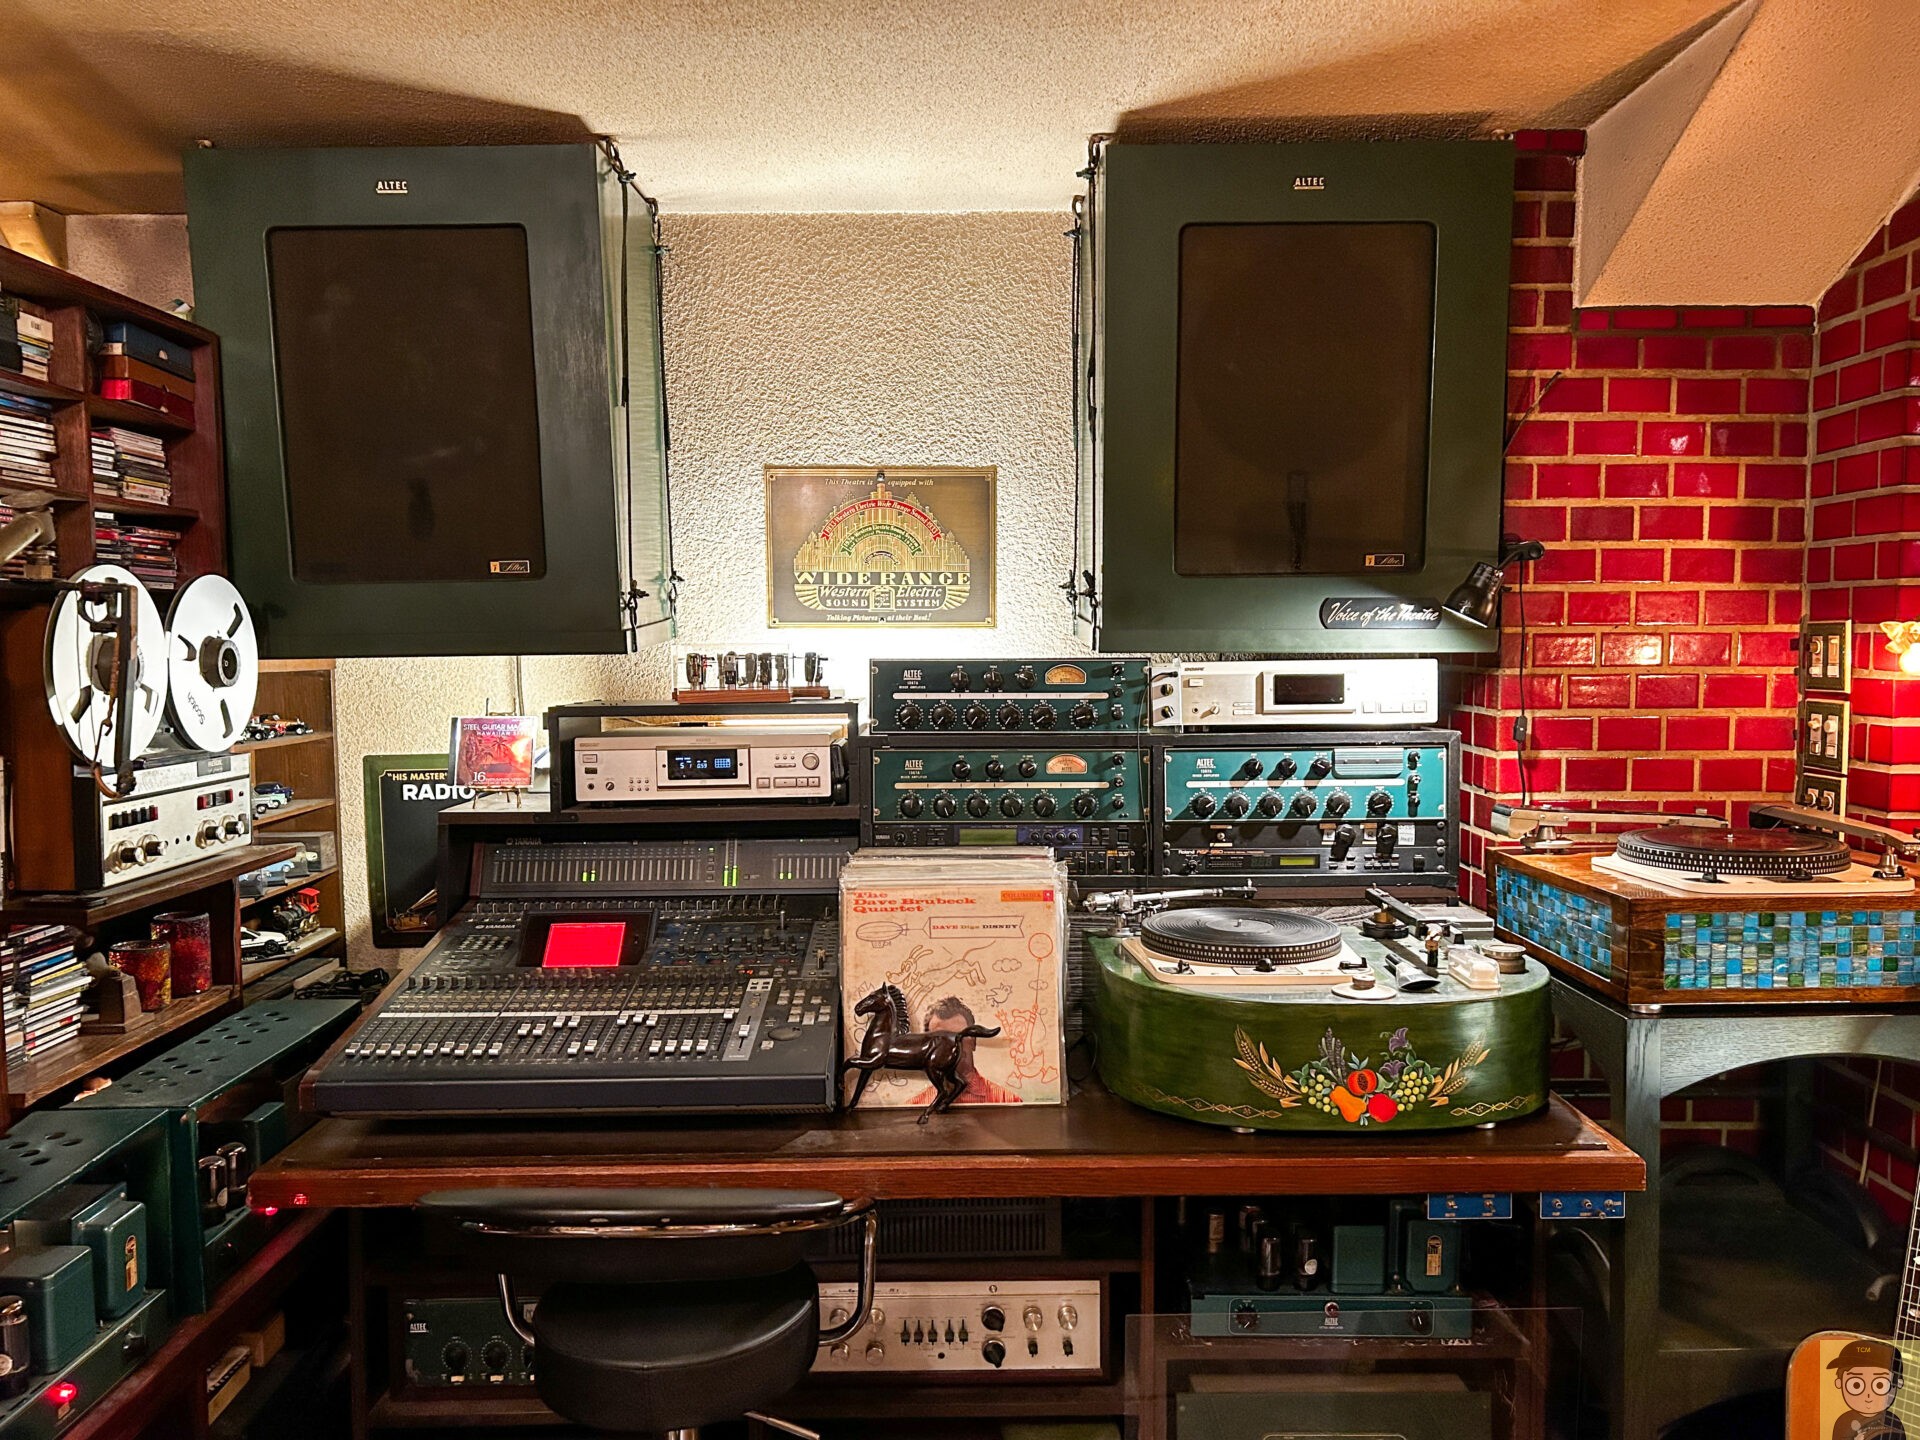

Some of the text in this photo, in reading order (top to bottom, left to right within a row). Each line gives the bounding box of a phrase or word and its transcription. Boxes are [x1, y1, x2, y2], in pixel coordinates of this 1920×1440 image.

[378, 181, 408, 191] ALTEC
[1295, 177, 1325, 187] ALTEC
[888, 479, 916, 487] equipped
[856, 501, 876, 512] Electric
[877, 500, 892, 508] Wide
[892, 501, 912, 514] Range
[794, 572, 971, 585] WIDE RANGE
[819, 586, 870, 598] Western
[896, 586, 942, 598] Electric
[826, 599, 940, 608] SOUND SYSTEM
[827, 614, 851, 622] Talking
[1327, 600, 1439, 628] Voice of the Theatre
[903, 669, 922, 680] ALTEC
[905, 760, 924, 770] ALTEC
[1197, 758, 1215, 768] ALTEC
[473, 772, 486, 781] 16
[402, 783, 476, 800] RADIO
[900, 898, 976, 906] Brubeck
[853, 905, 924, 913] Quartet
[410, 1322, 427, 1333] ALTEC
